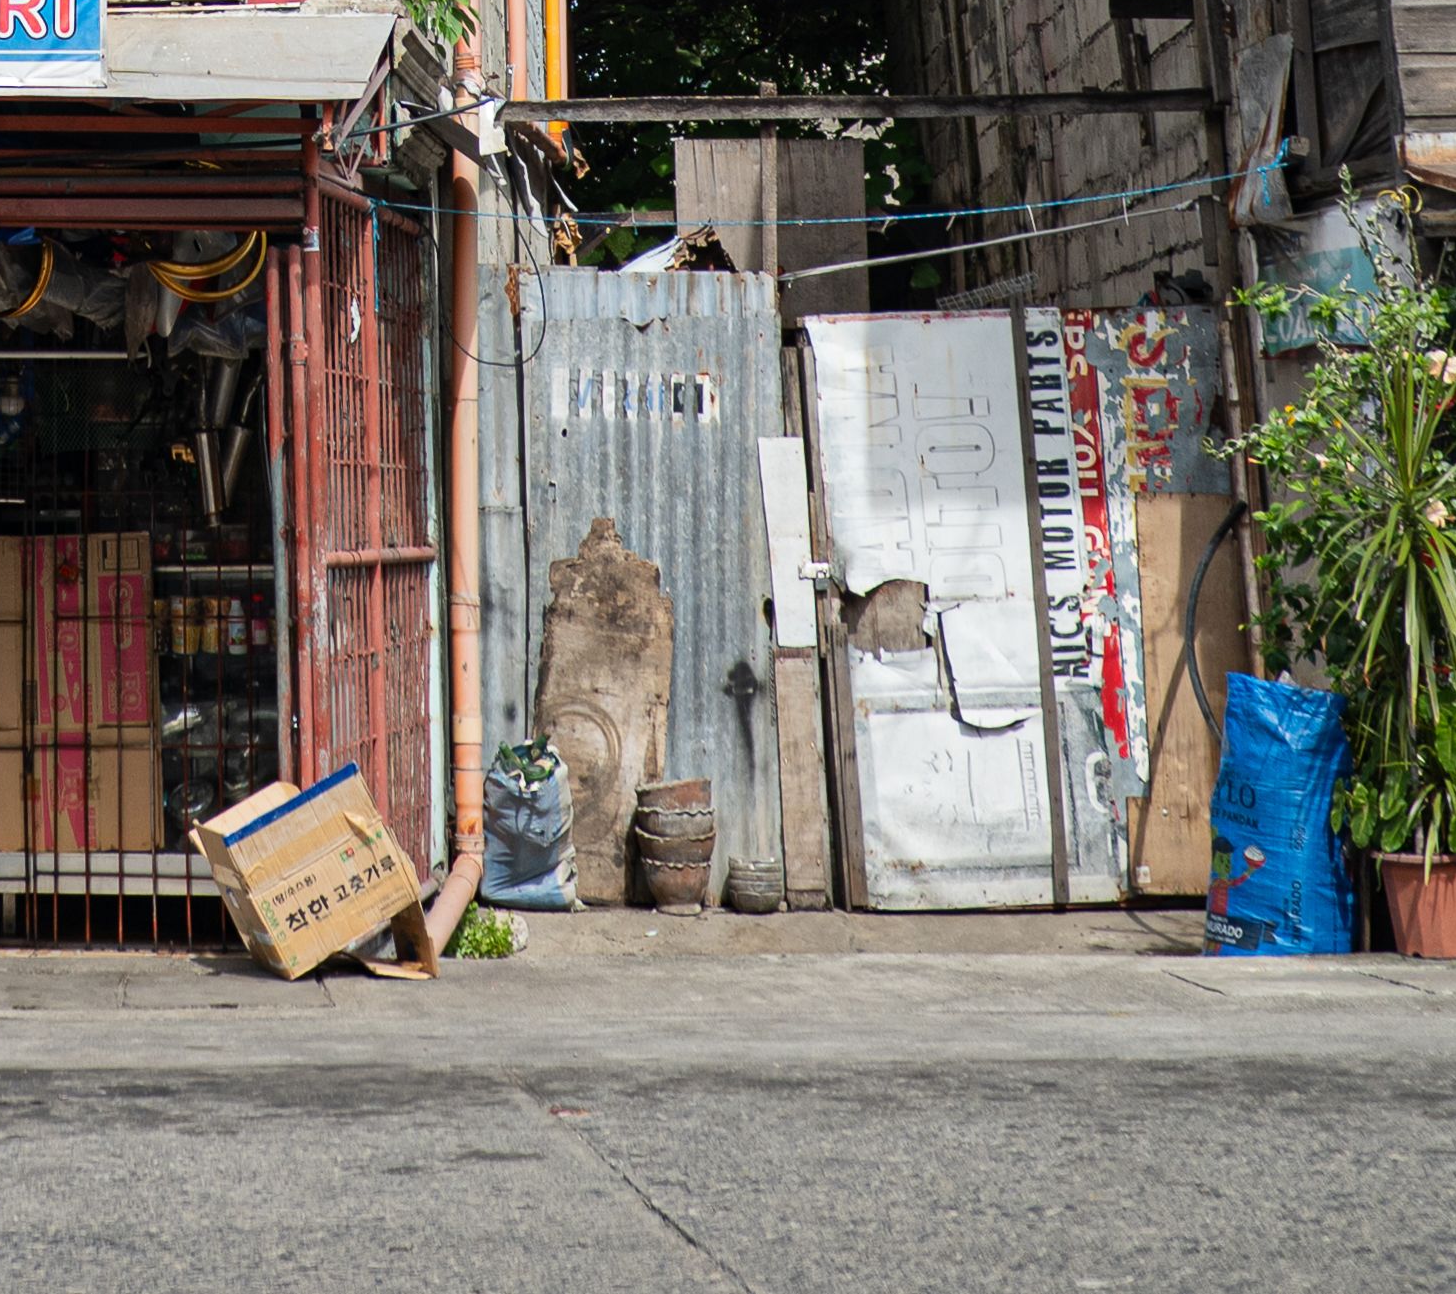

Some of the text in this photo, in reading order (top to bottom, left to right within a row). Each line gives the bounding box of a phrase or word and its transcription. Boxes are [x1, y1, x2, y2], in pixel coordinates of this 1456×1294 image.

[1025, 329, 1065, 436] PARTS
[1036, 456, 1076, 572] MOTOR
[285, 895, 330, 932] 착한
[333, 855, 396, 904] 고춧가루
